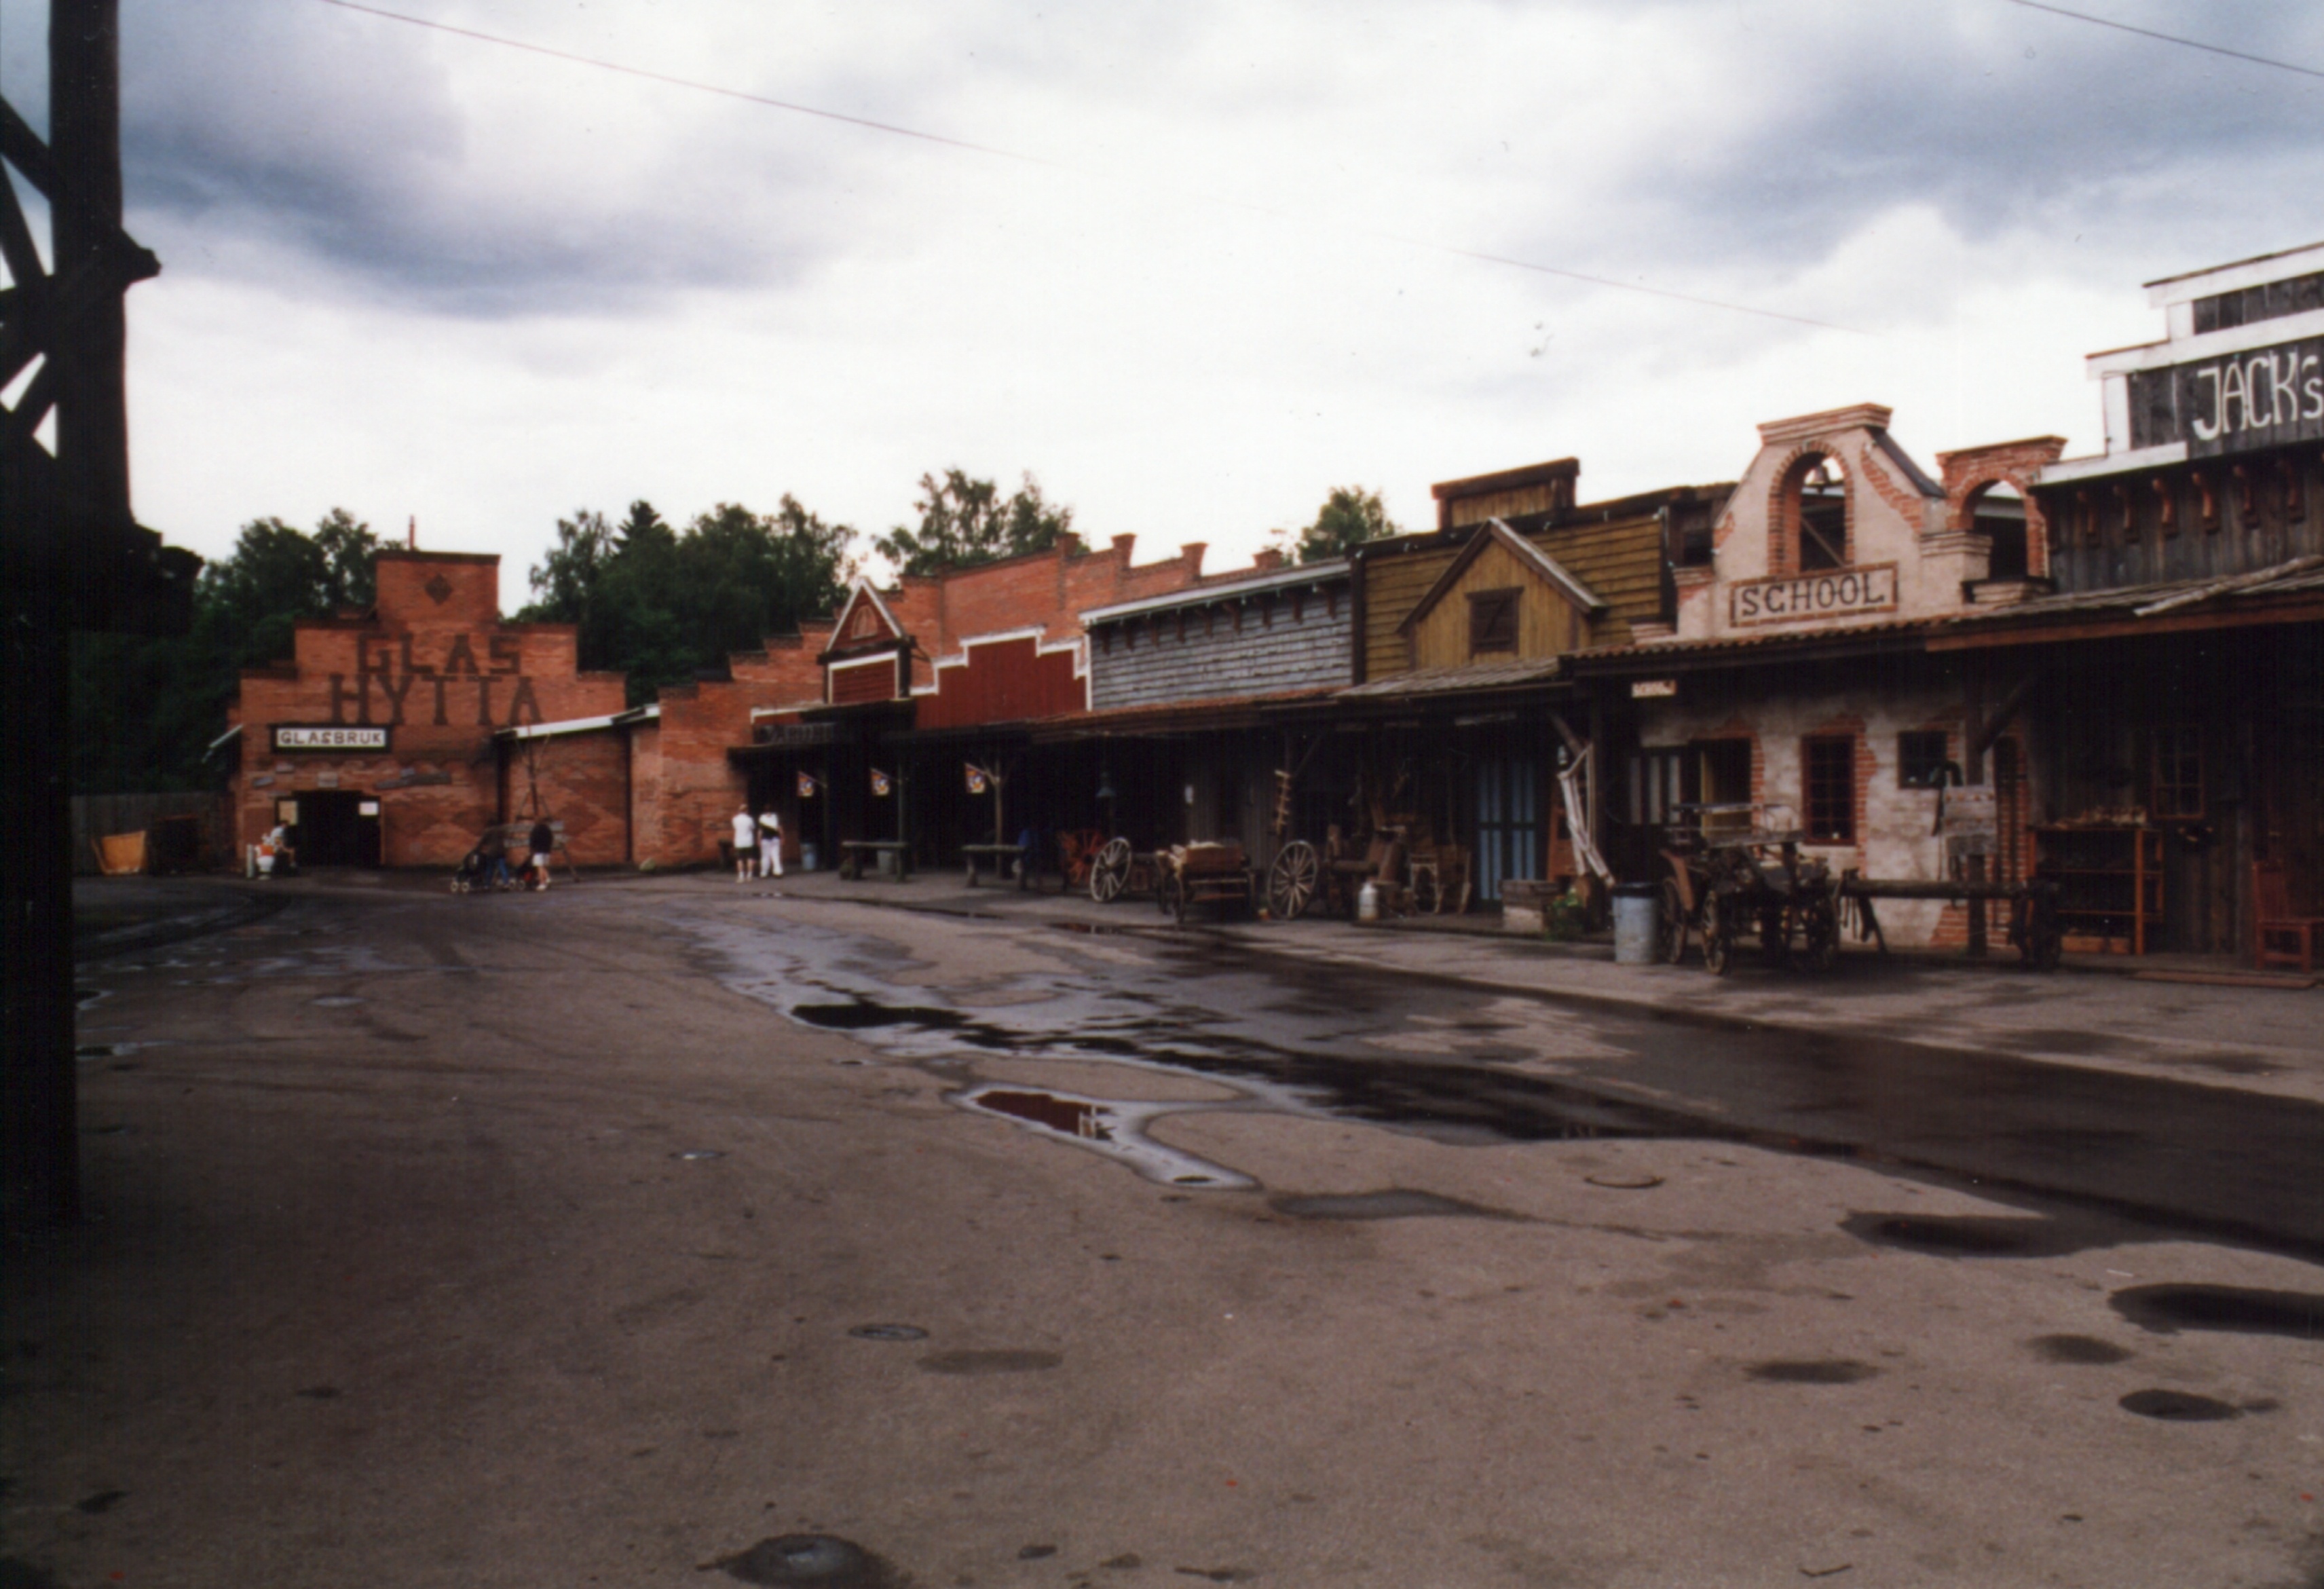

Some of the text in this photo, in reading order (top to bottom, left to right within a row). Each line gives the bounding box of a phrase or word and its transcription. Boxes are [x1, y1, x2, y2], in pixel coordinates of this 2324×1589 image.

[2192, 351, 2324, 441] JACK's
[1742, 574, 1885, 616] SCHOOL
[357, 633, 520, 674] GLAS
[329, 674, 545, 725] HYTTA
[280, 731, 381, 745] GLASBRUK
